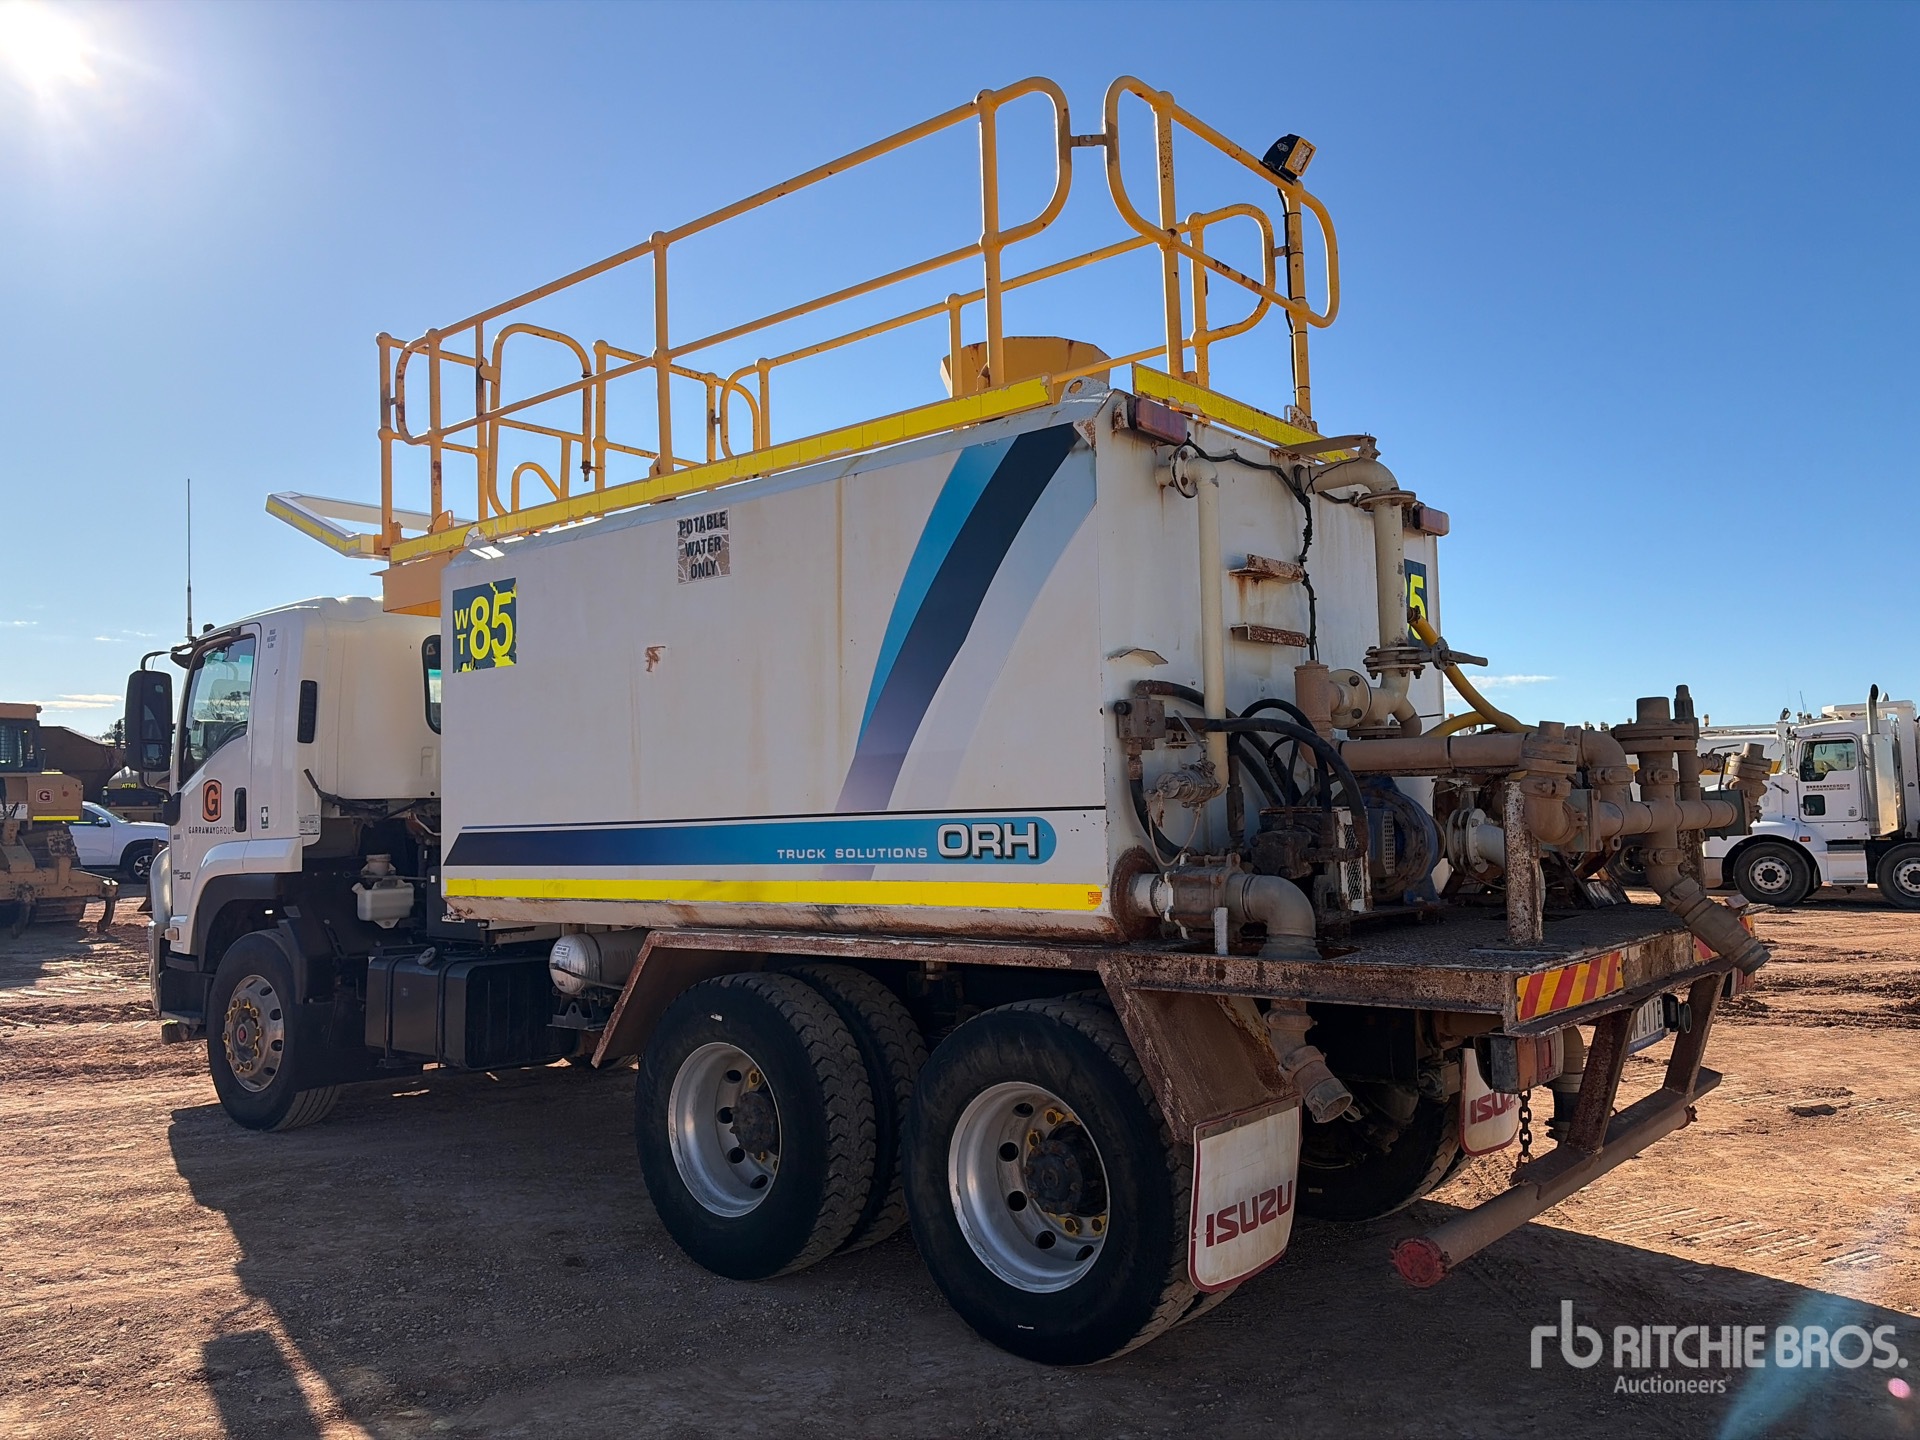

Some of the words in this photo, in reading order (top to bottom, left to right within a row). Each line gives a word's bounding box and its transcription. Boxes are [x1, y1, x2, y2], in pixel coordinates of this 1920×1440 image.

[680, 512, 726, 535] POTABLE
[685, 537, 721, 557] WATER
[691, 560, 716, 578] ONLY
[1405, 573, 1427, 640] 5
[469, 591, 513, 660] 85
[204, 783, 219, 818] G
[777, 848, 826, 859] TRUCK
[835, 847, 928, 859] SOLUTIONS
[937, 822, 1037, 858] ORH
[1470, 1092, 1516, 1125] ISU
[1205, 1180, 1293, 1247] ISUZU
